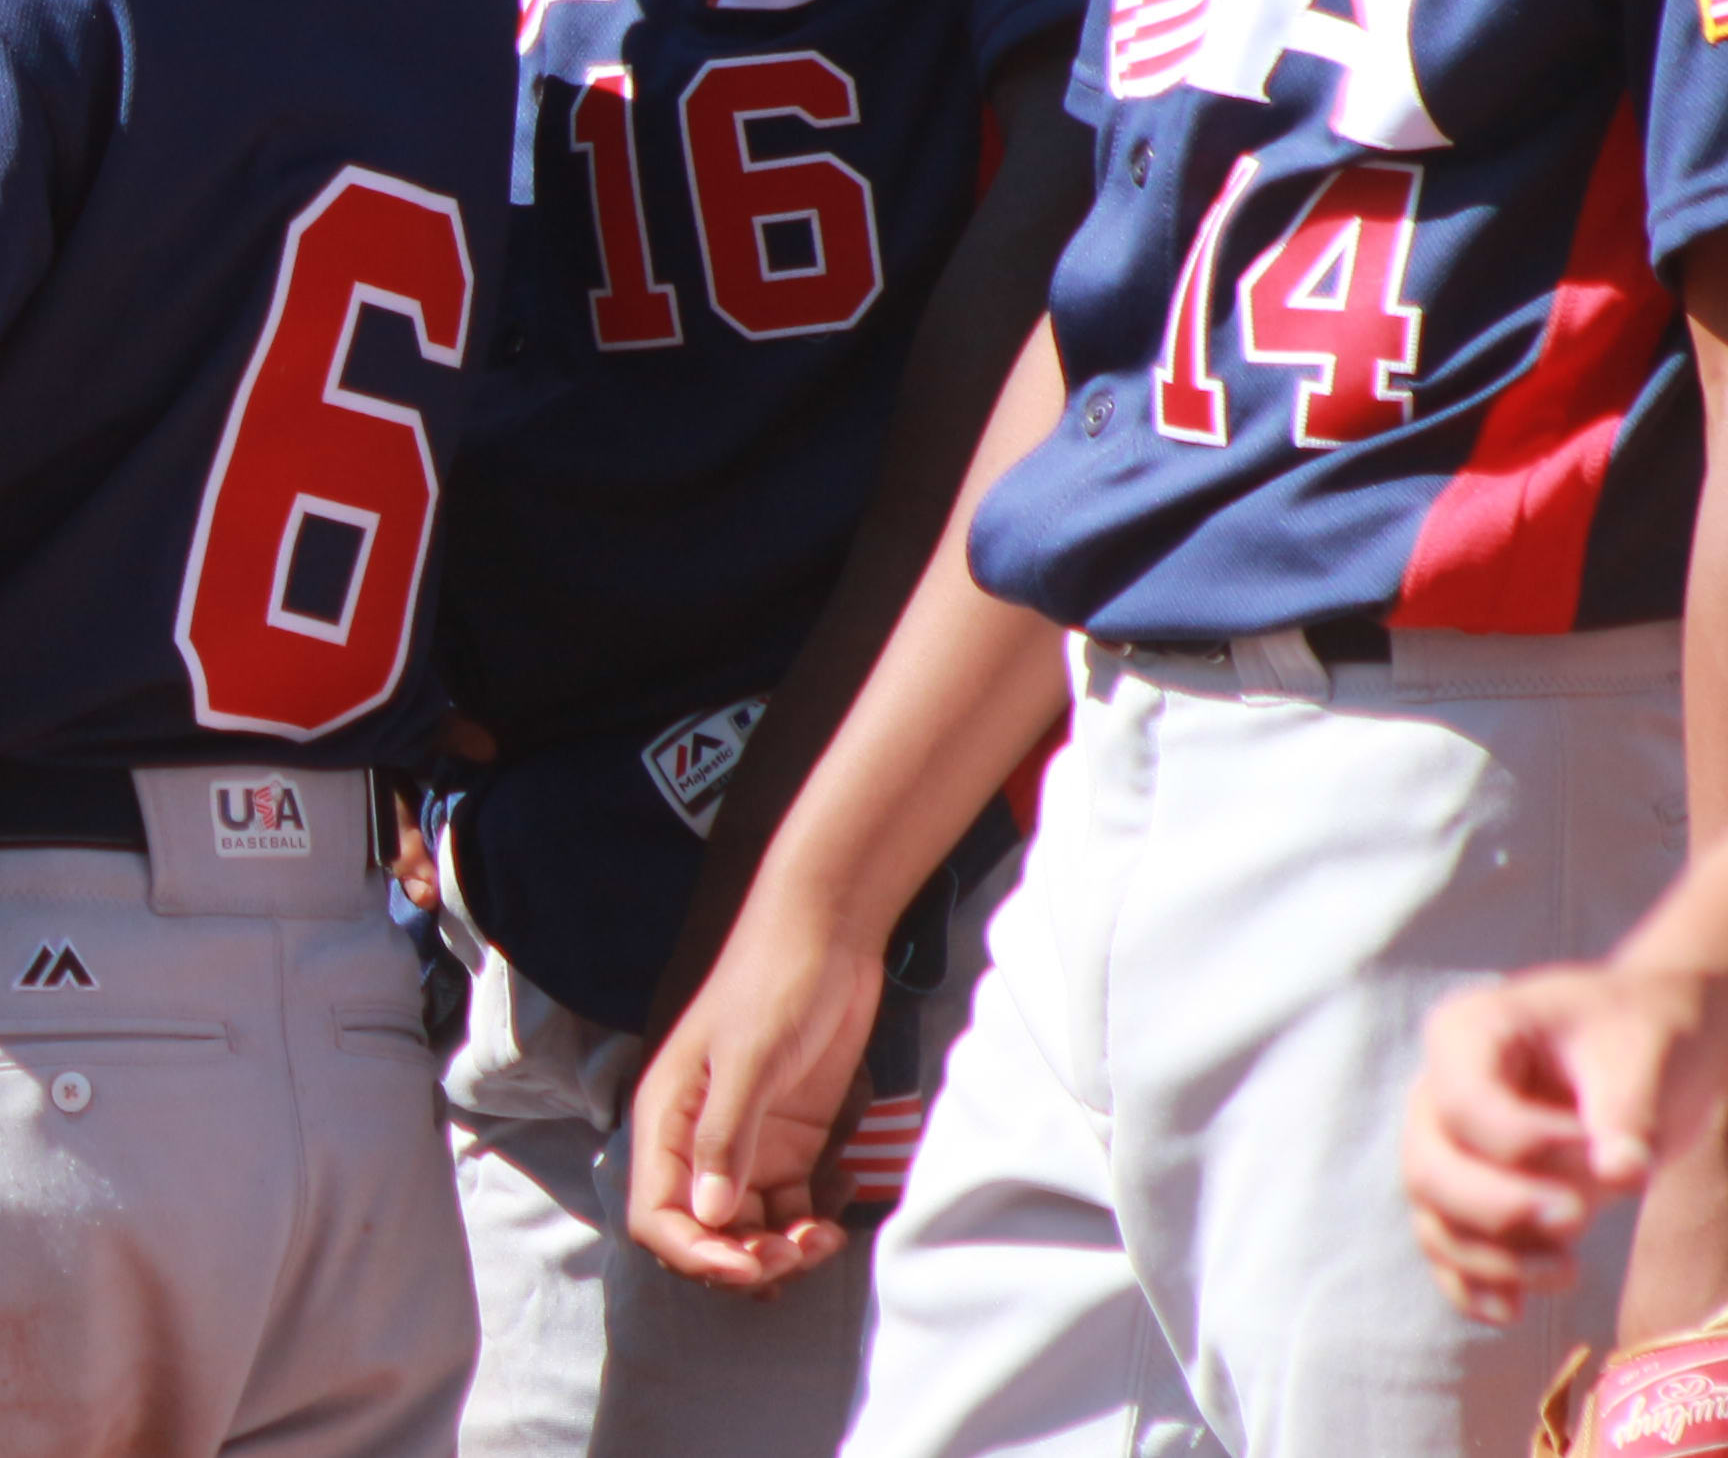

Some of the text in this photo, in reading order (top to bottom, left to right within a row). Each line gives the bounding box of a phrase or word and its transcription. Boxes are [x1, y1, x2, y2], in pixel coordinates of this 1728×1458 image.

[569, 50, 885, 353] 16
[1152, 152, 1424, 450] 14
[173, 164, 475, 744] 6
[216, 780, 306, 832] USA
[221, 836, 307, 850] BASEBALL
[677, 746, 735, 793] Majestic
